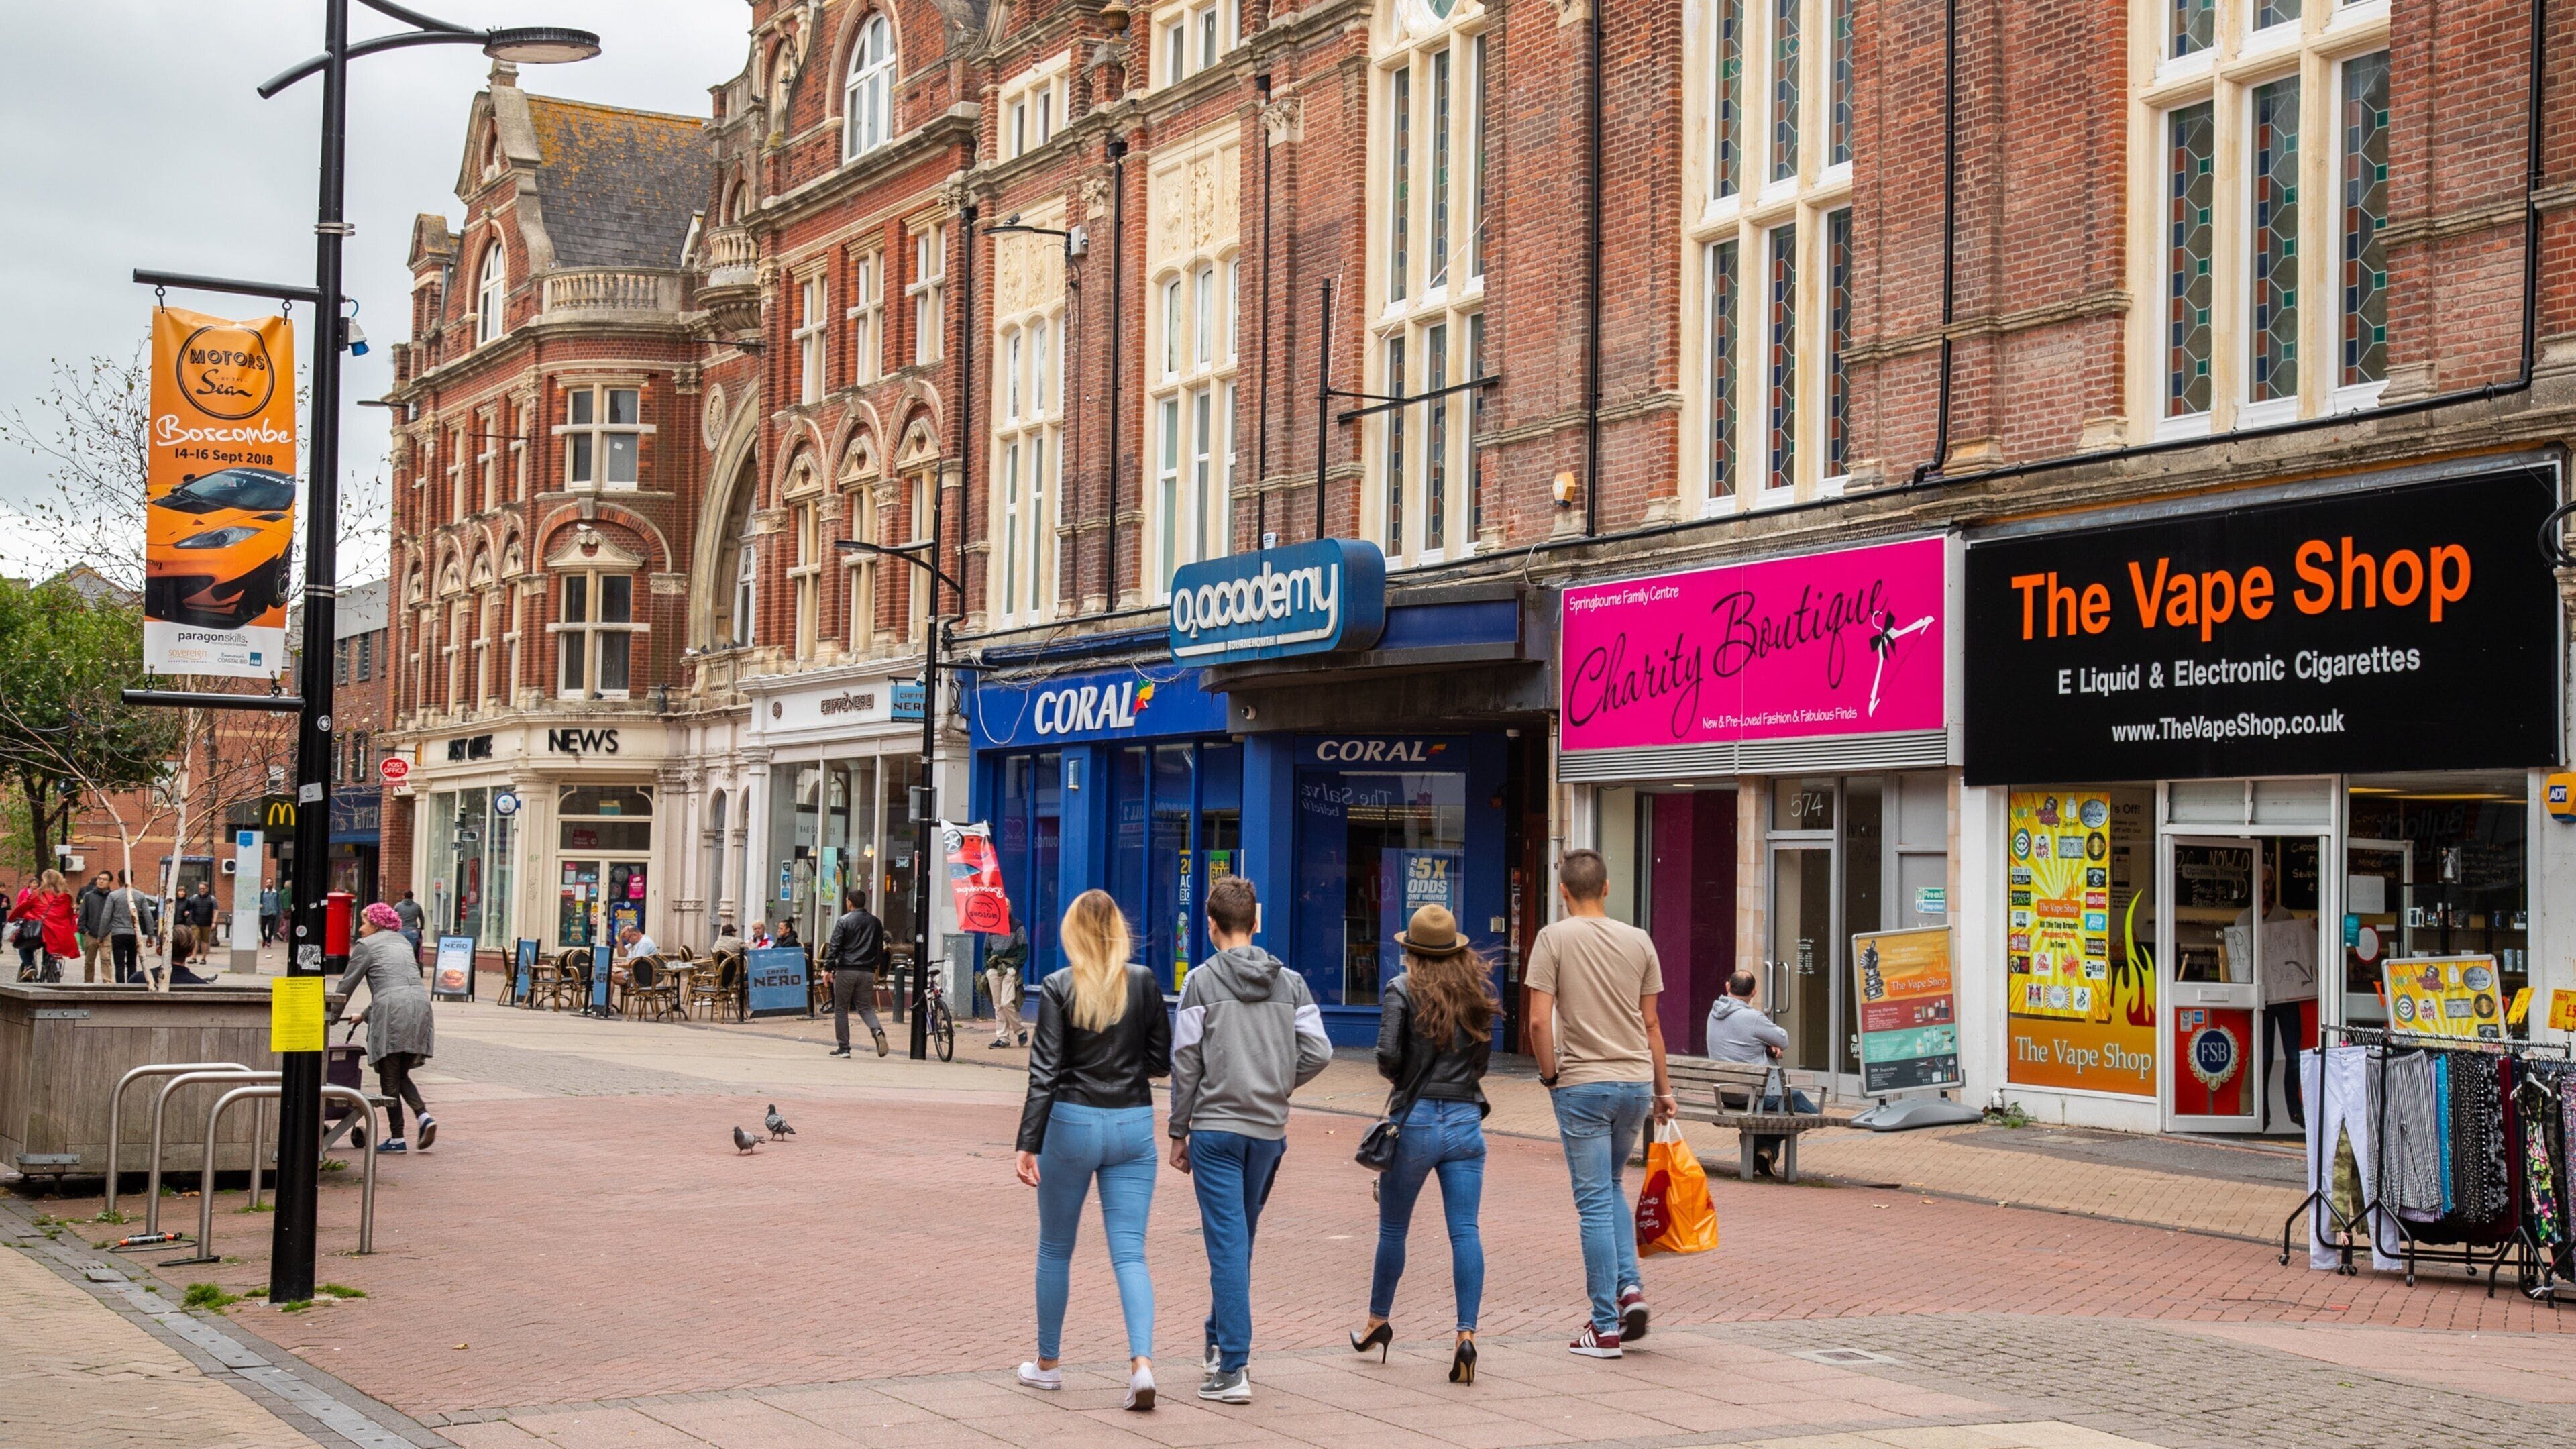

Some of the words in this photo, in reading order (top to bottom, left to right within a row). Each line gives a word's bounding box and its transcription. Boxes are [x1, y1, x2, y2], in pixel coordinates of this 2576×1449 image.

[190, 349, 265, 370] MOTORS
[156, 414, 292, 446] Boscombe
[175, 448, 209, 460] 14-16
[213, 449, 243, 464] Sept
[247, 453, 274, 466] 2018
[2011, 571, 2111, 641] The
[2128, 557, 2275, 642] Vape
[2293, 536, 2471, 623] Shop
[1569, 594, 1621, 615] Springbourne
[1623, 588, 1649, 605] Family
[1650, 586, 1679, 600] Centre
[1227, 636, 1275, 650] BOURNEMOUTH
[168, 649, 207, 658] sovereign
[1568, 633, 1703, 739] Charity
[1711, 579, 1888, 689] Boutique
[2059, 669, 2071, 694] E
[2080, 664, 2139, 696] Liquid
[2149, 662, 2164, 688] &
[2174, 654, 2284, 686] Electronic
[2295, 646, 2420, 683] Cigarettes
[1034, 681, 1135, 735] CORAL
[1703, 717, 1717, 729] New
[1719, 716, 1725, 728] &
[1726, 714, 1762, 727] Pre-Loved
[1763, 712, 1792, 725] Fashion
[1792, 710, 1799, 722] &
[1801, 708, 1835, 721] Fabulous
[1835, 706, 1857, 720] Finds
[2112, 708, 2345, 742] www.TheVapeShop.co.uk
[549, 729, 619, 753] NEWS
[1317, 740, 1426, 761] CORAL
[2549, 788, 2567, 800] ADT
[1791, 792, 1823, 817] 574
[2123, 804, 2141, 814] Off!
[1211, 859, 1221, 867] THE
[1411, 858, 1417, 866] TO
[1409, 867, 1415, 877] UP
[1407, 879, 1447, 894] ODDS
[2039, 903, 2049, 911] The
[2050, 904, 2064, 914] Vape
[2064, 904, 2078, 915] Shop
[754, 975, 801, 987] NERO
[1891, 981, 1906, 991] The
[1907, 980, 1926, 990] Vape
[1927, 977, 1947, 988] Shop
[2556, 993, 2570, 1002] Only
[2015, 1036, 2048, 1062] The
[2053, 1039, 2098, 1074] Vape
[2104, 1043, 2152, 1079] Shop
[2200, 1042, 2227, 1061] FSB
